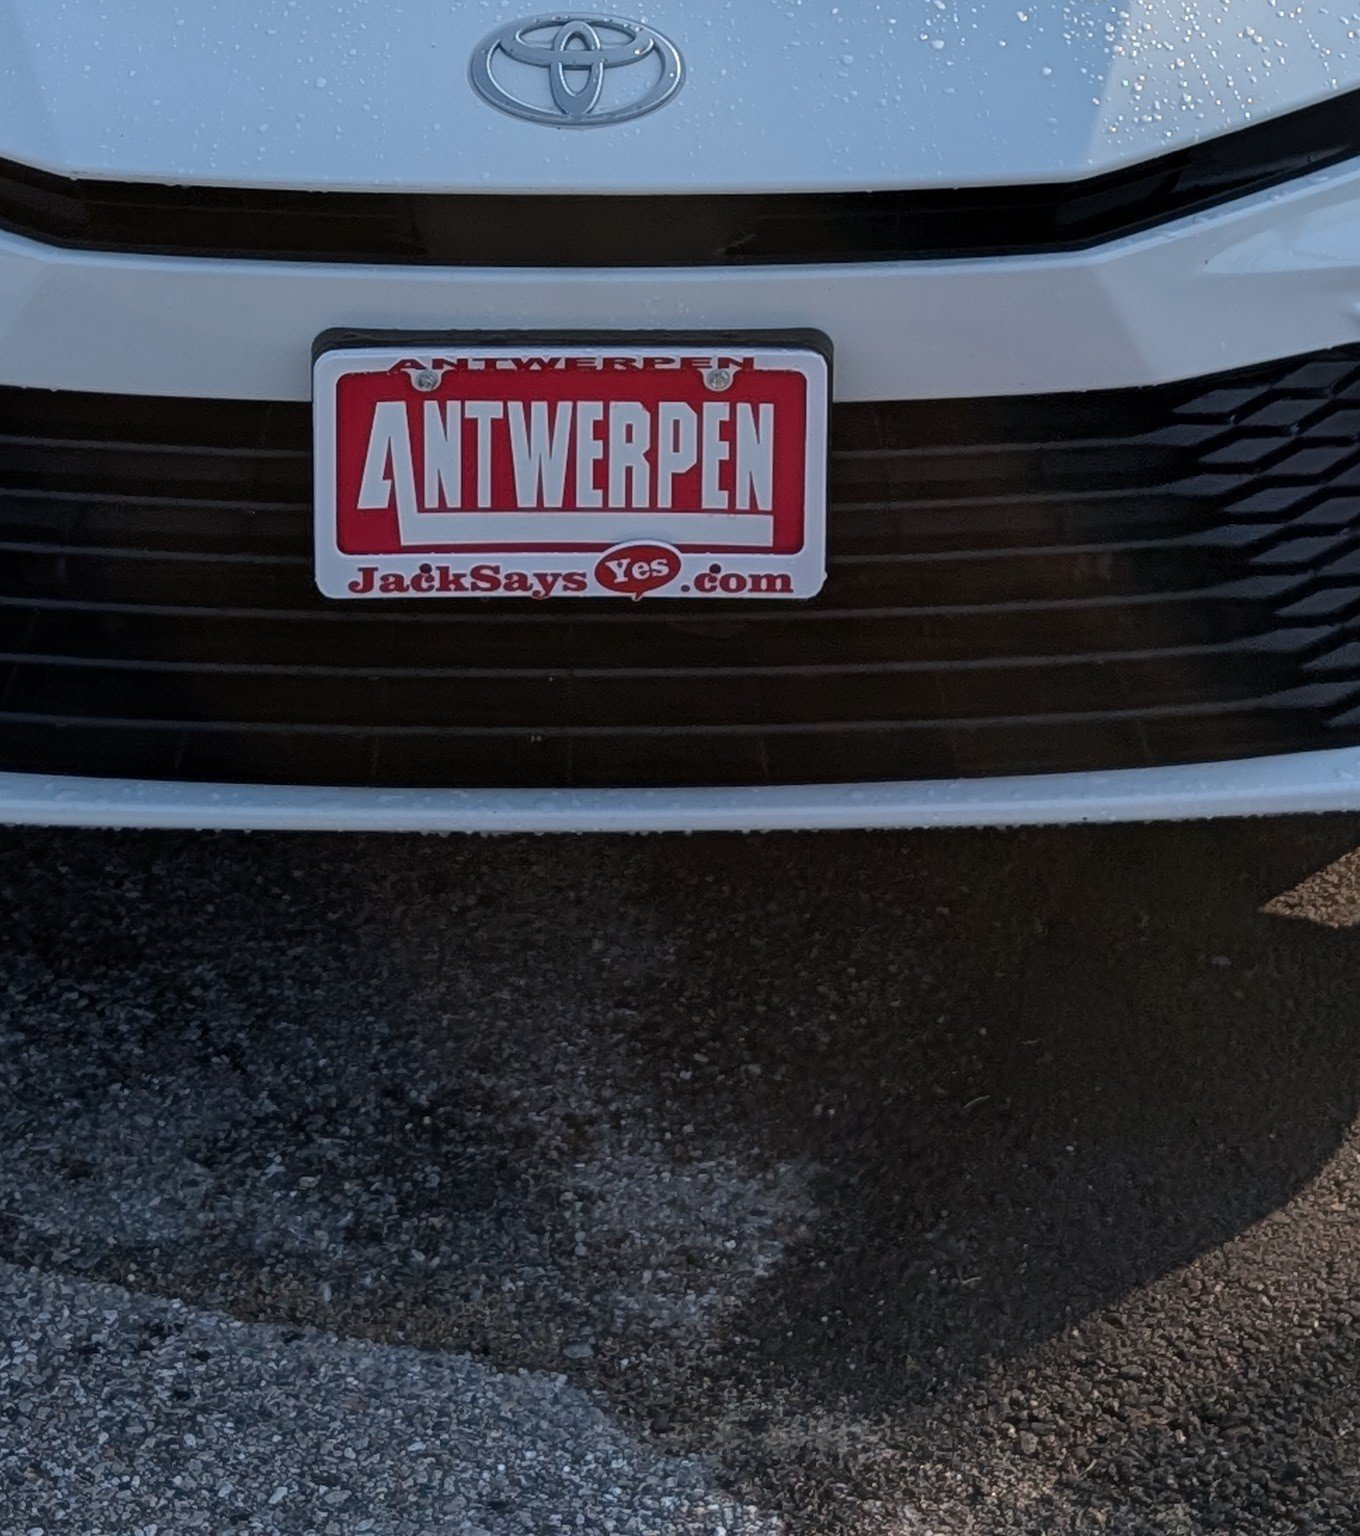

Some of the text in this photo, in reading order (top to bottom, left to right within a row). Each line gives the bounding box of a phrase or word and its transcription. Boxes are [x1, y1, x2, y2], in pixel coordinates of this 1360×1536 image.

[388, 356, 756, 371] ANTWERPEN
[356, 399, 775, 544] ANTWERPEN
[348, 565, 588, 599] JackSays
[605, 556, 669, 584] Yes
